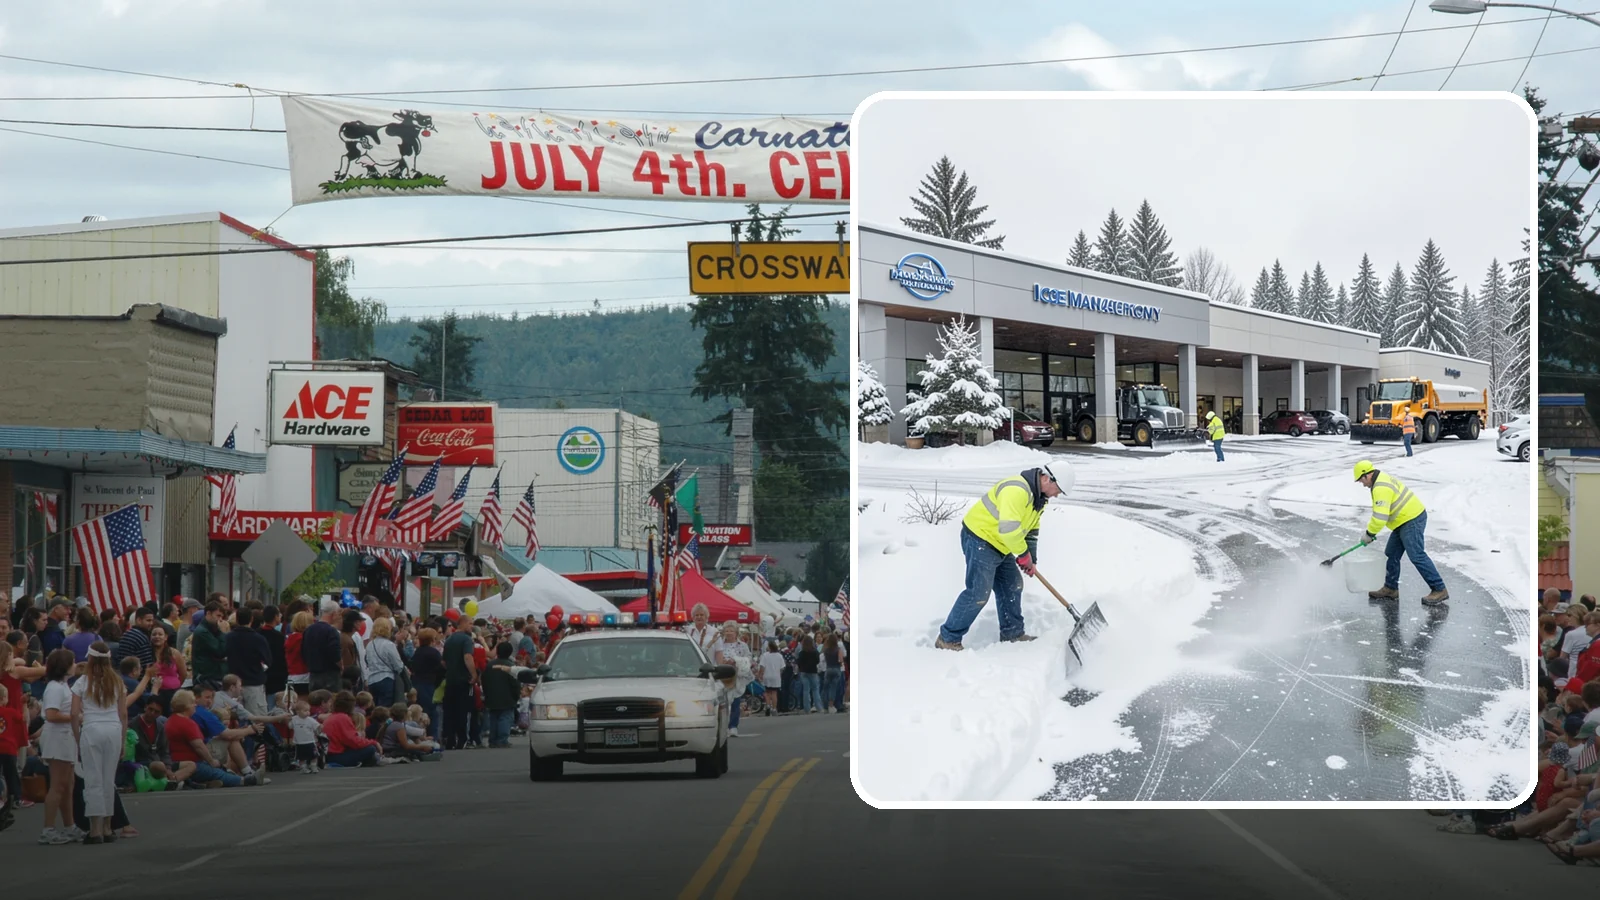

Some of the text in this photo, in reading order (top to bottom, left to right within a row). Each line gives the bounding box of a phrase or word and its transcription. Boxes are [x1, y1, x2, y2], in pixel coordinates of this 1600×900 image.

[481, 141, 604, 192] JULY
[632, 150, 746, 197] 4th.
[697, 254, 850, 280] CROSSWA
[282, 380, 373, 420] ACE
[405, 409, 453, 422] CEDAR
[283, 421, 371, 437] Hardware
[353, 467, 384, 480] Simpl
[83, 485, 155, 495] St. Vincent de Paul
[688, 527, 741, 535] CRNATION
[700, 535, 730, 544] GLASS
